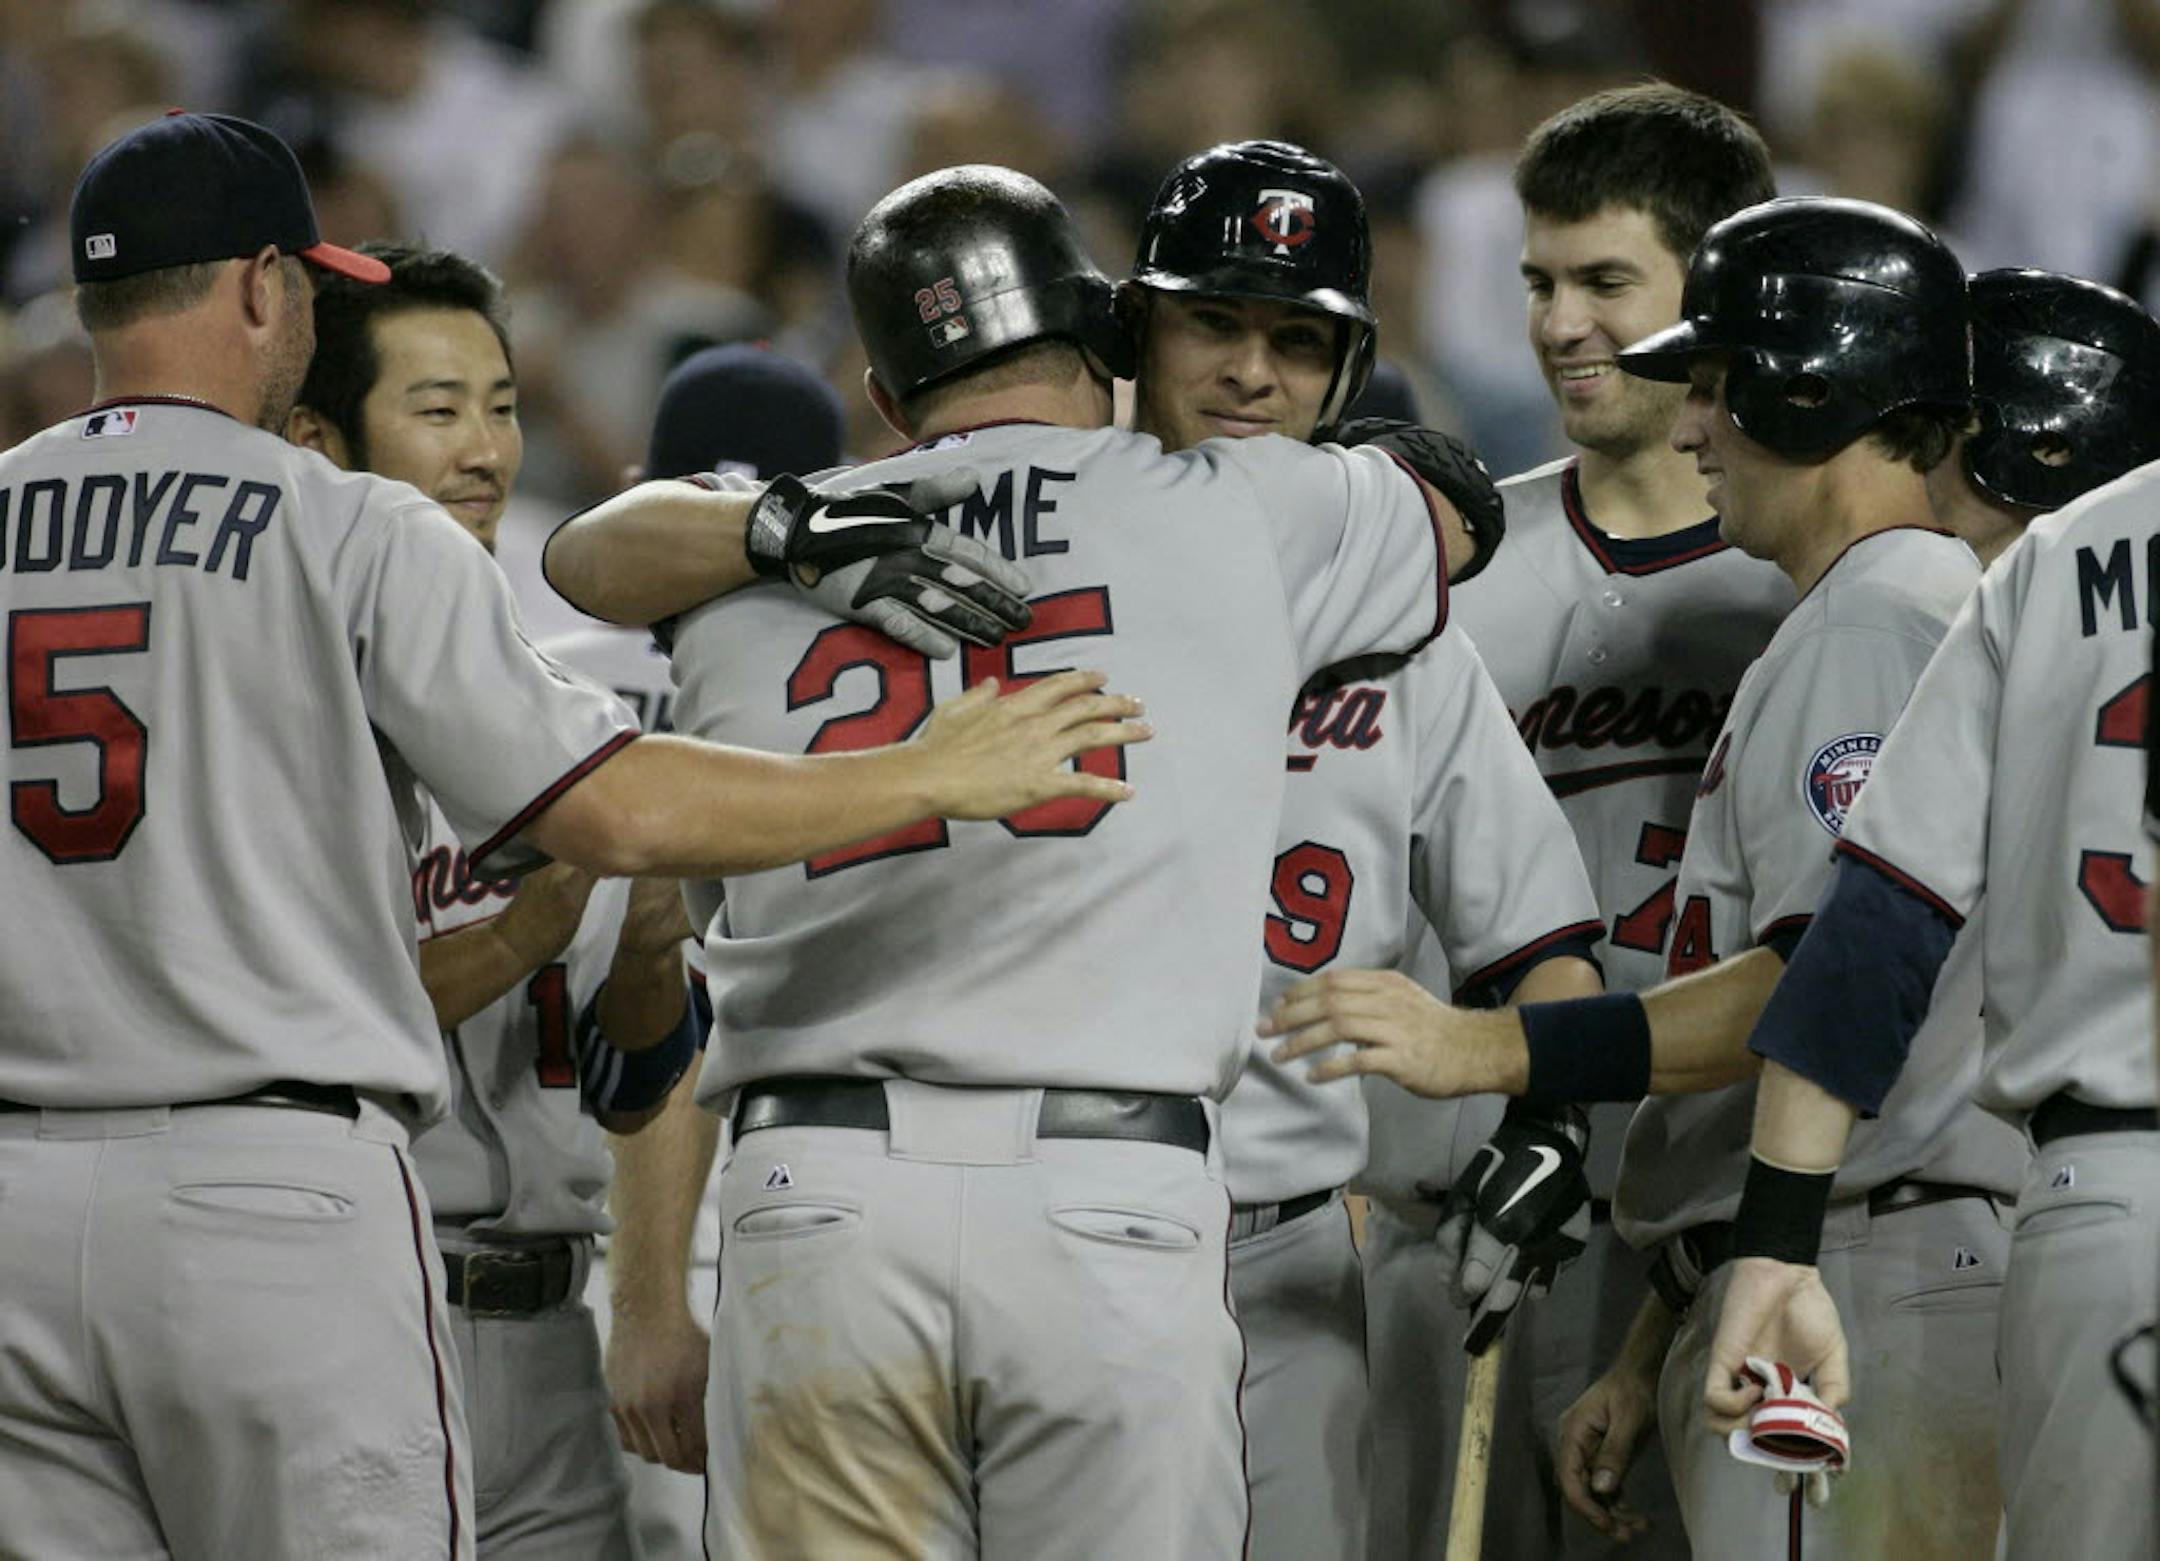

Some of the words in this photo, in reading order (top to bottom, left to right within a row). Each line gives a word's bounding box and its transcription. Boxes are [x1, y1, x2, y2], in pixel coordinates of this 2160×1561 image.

[914, 277, 962, 323] 25
[0, 471, 283, 581] DDYER
[8, 602, 152, 865] 5
[1819, 739, 1880, 766] MINNES
[1264, 840, 1354, 975] 9
[527, 962, 578, 1089] 1
